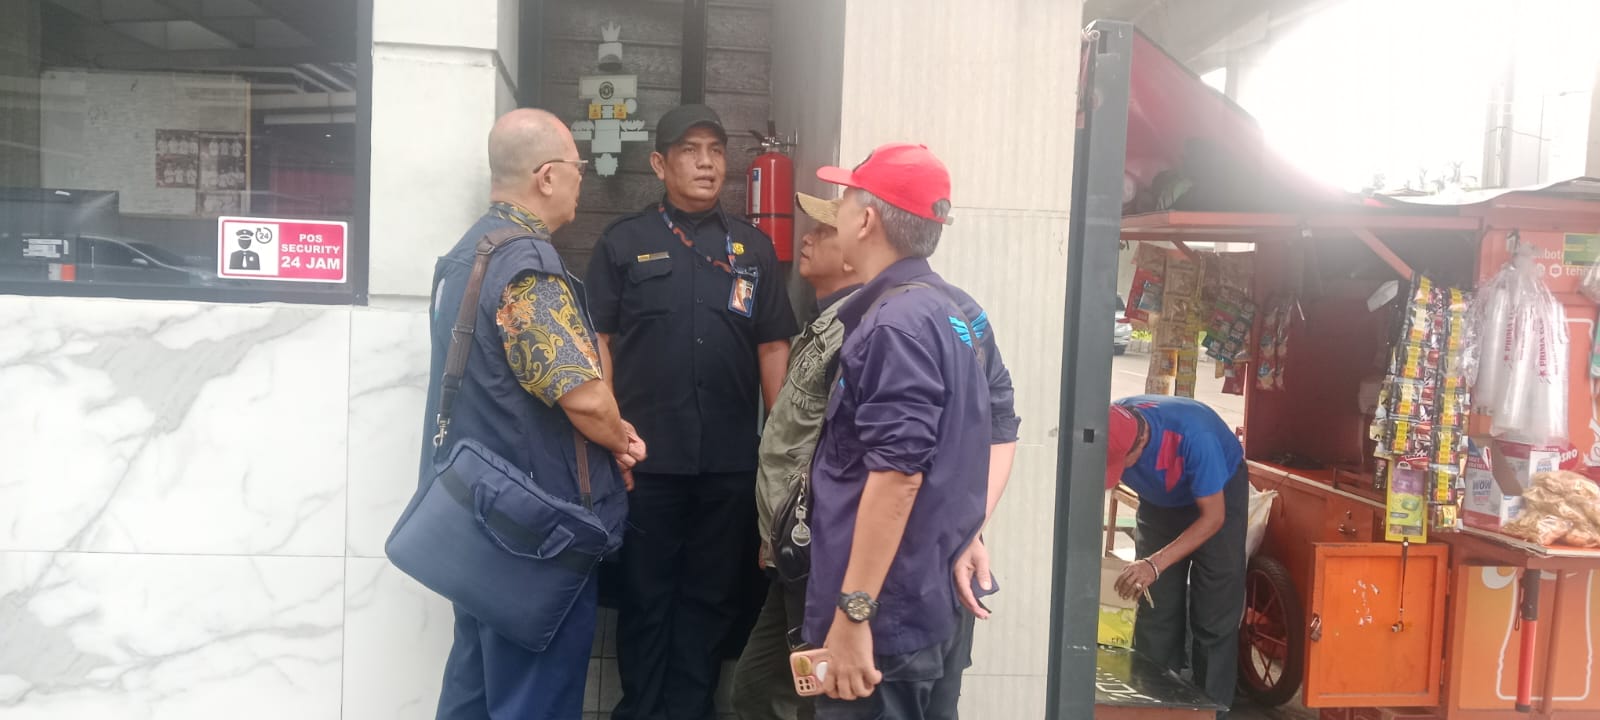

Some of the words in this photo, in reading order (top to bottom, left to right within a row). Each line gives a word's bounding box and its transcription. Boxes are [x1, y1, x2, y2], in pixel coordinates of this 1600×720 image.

[299, 234, 323, 242] POS
[281, 244, 340, 254] SECURITY
[281, 256, 301, 268] 24
[306, 257, 340, 270] JAM
[1539, 337, 1547, 367] PRIMA
